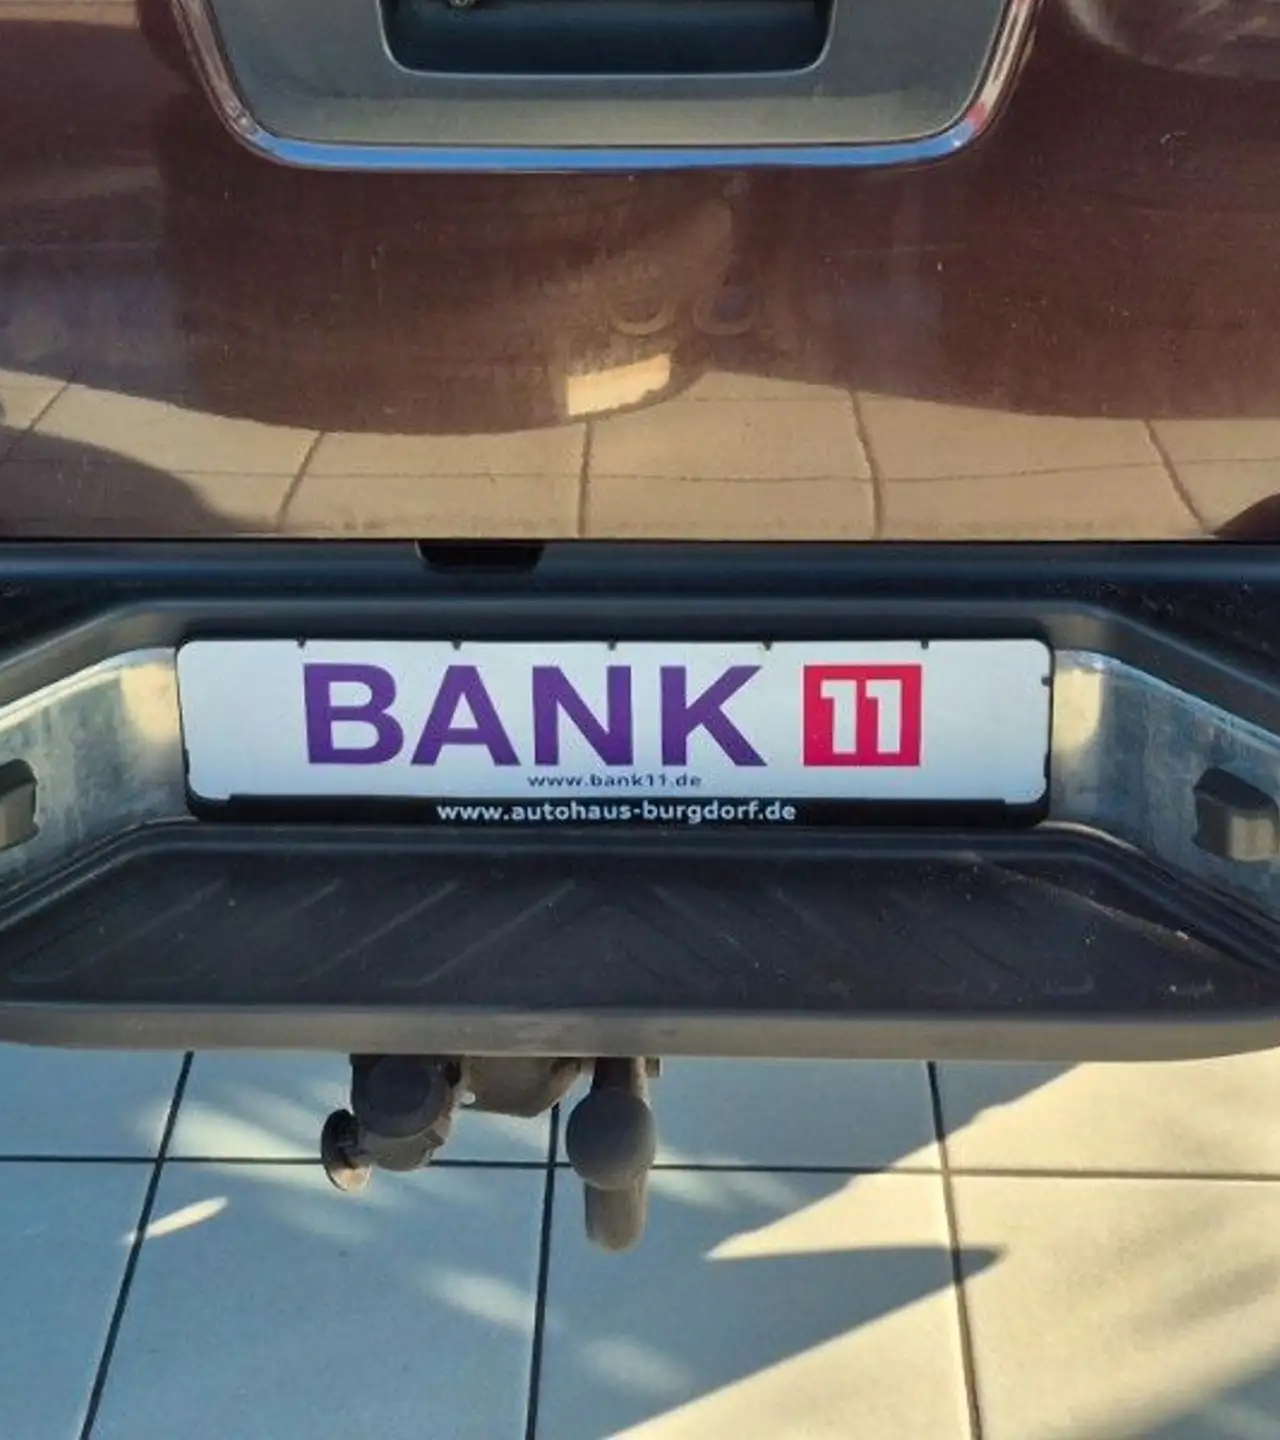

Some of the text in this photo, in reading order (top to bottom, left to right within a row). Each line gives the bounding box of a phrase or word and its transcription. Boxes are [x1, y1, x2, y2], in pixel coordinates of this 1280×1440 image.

[303, 663, 903, 767] BANK 11
[527, 773, 703, 788] www.bank11.de
[436, 800, 797, 825] www.autohaus-burgdorf.de
